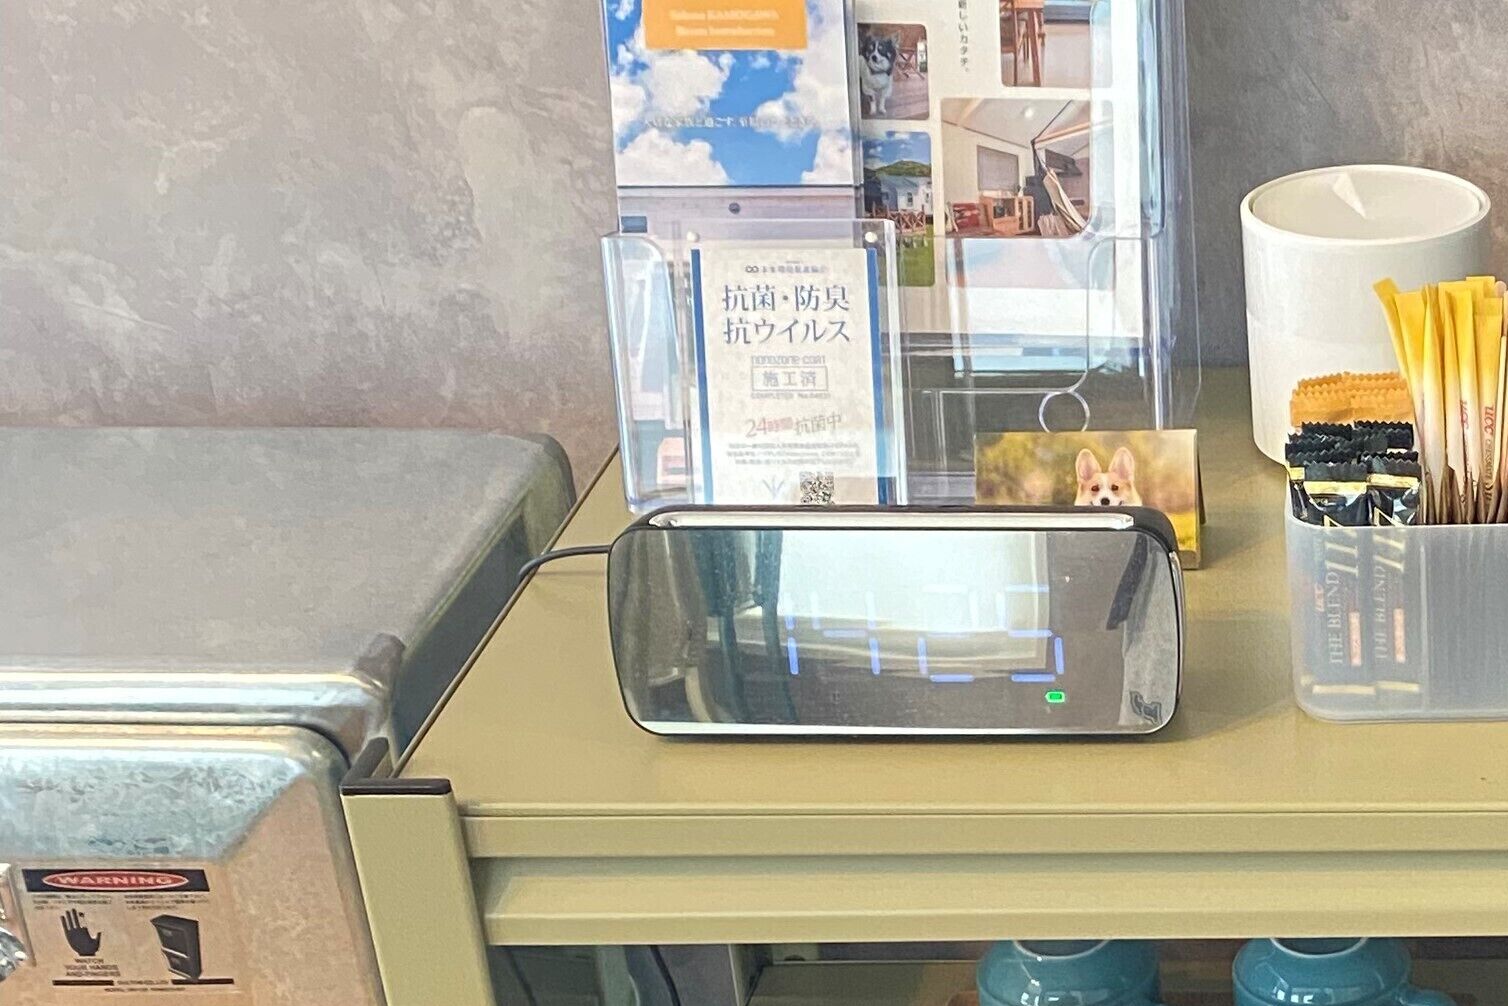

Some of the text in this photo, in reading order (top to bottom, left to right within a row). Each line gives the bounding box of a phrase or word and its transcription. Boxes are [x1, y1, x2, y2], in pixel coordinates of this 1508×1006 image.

[722, 284, 850, 312] 抗菌・防臭
[723, 317, 851, 345] 抗ウイルス
[57, 875, 172, 886] WARNING
